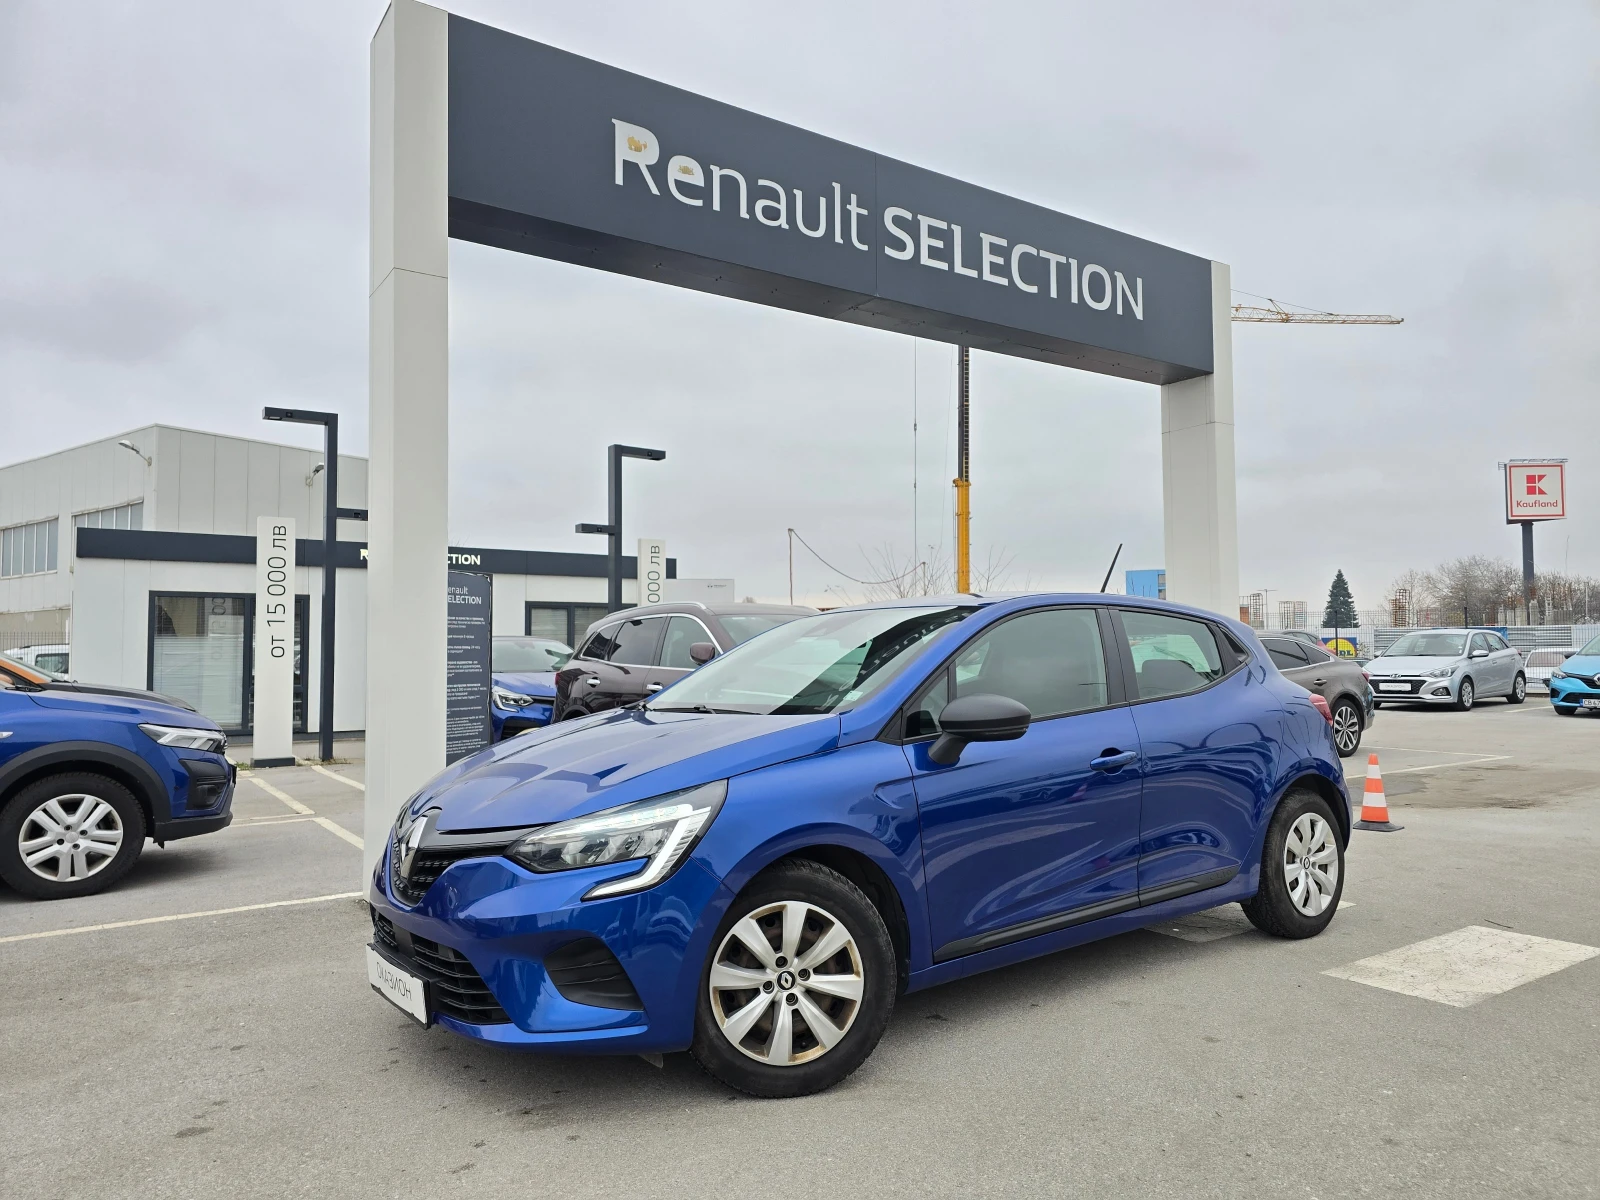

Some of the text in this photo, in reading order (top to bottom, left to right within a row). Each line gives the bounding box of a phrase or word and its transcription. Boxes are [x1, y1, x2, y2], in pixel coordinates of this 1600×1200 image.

[612, 118, 1144, 320] Renault SELECTION
[1516, 500, 1558, 508] Kaufland
[267, 556, 287, 597] 000
[266, 603, 286, 627] 15
